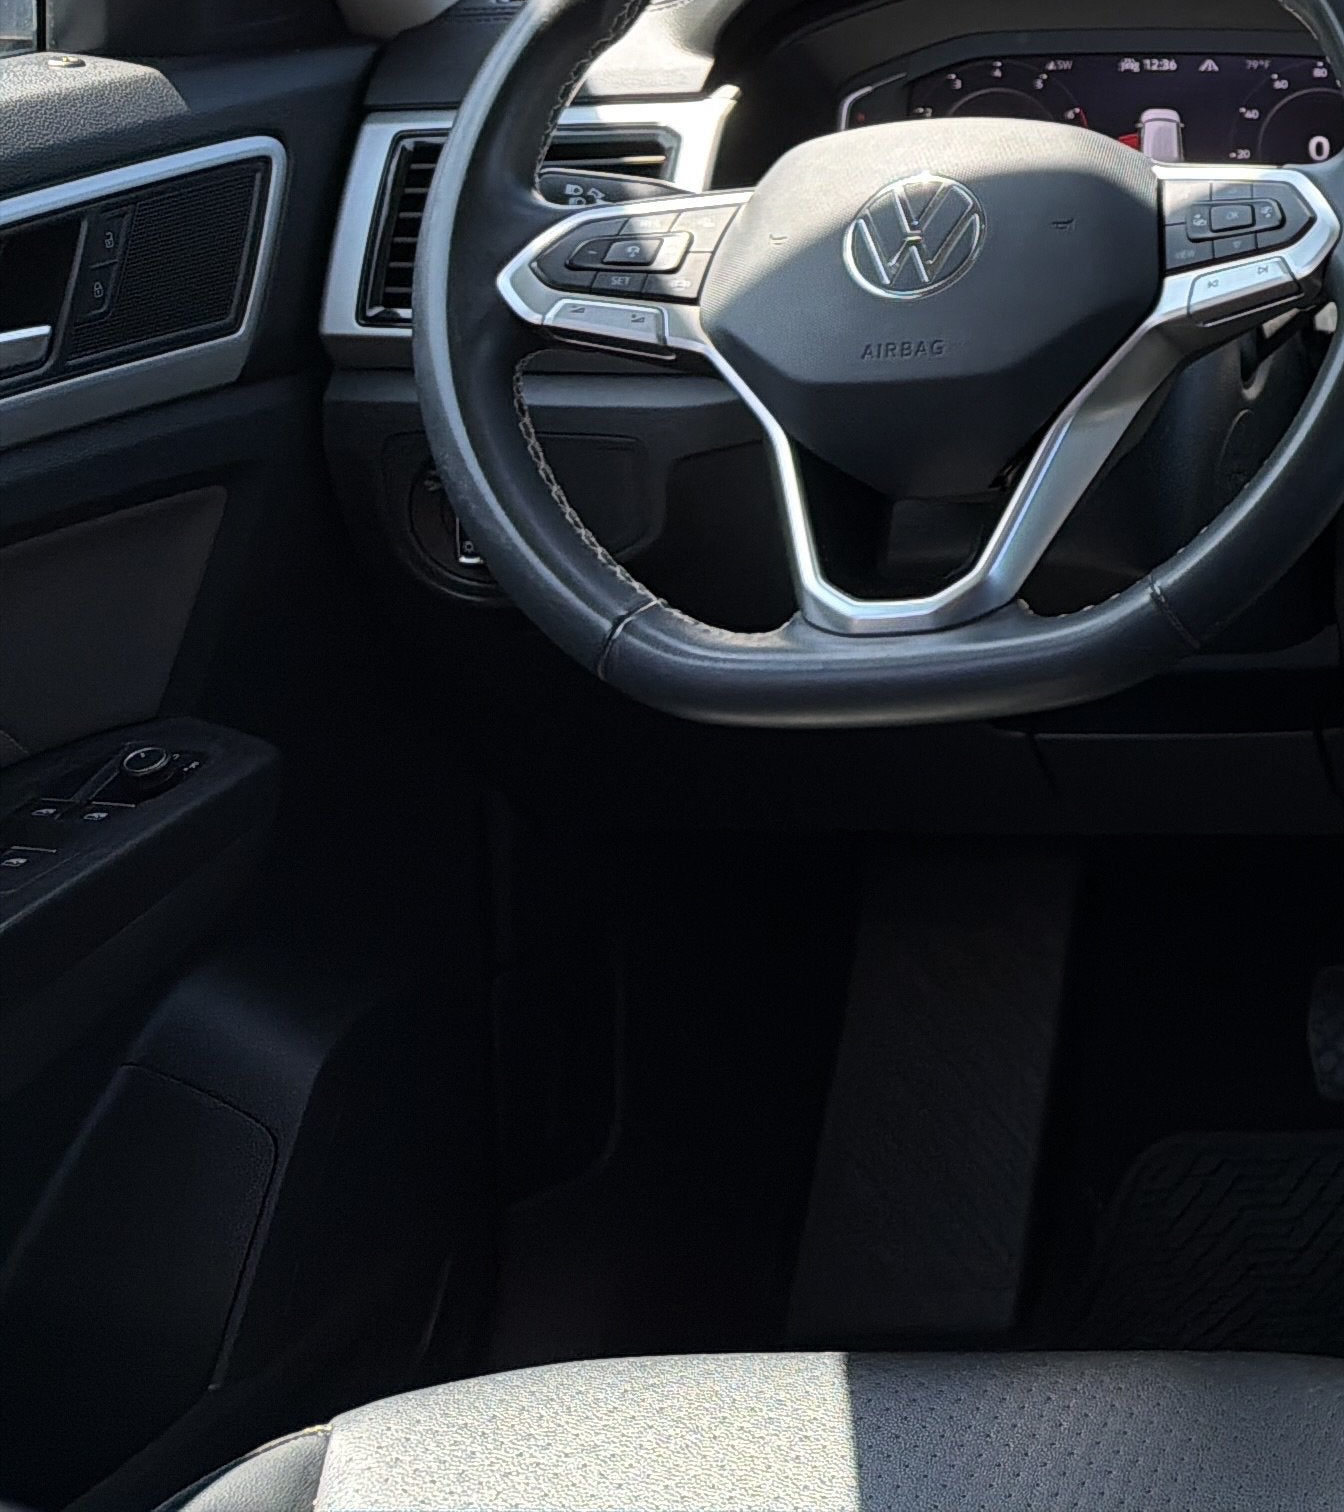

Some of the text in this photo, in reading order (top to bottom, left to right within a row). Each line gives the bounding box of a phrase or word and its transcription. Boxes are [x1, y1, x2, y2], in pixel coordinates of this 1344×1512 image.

[1143, 58, 1177, 71] 12:36
[1308, 135, 1330, 161] 0
[611, 276, 631, 285] SET
[860, 339, 945, 359] AIRBAG
